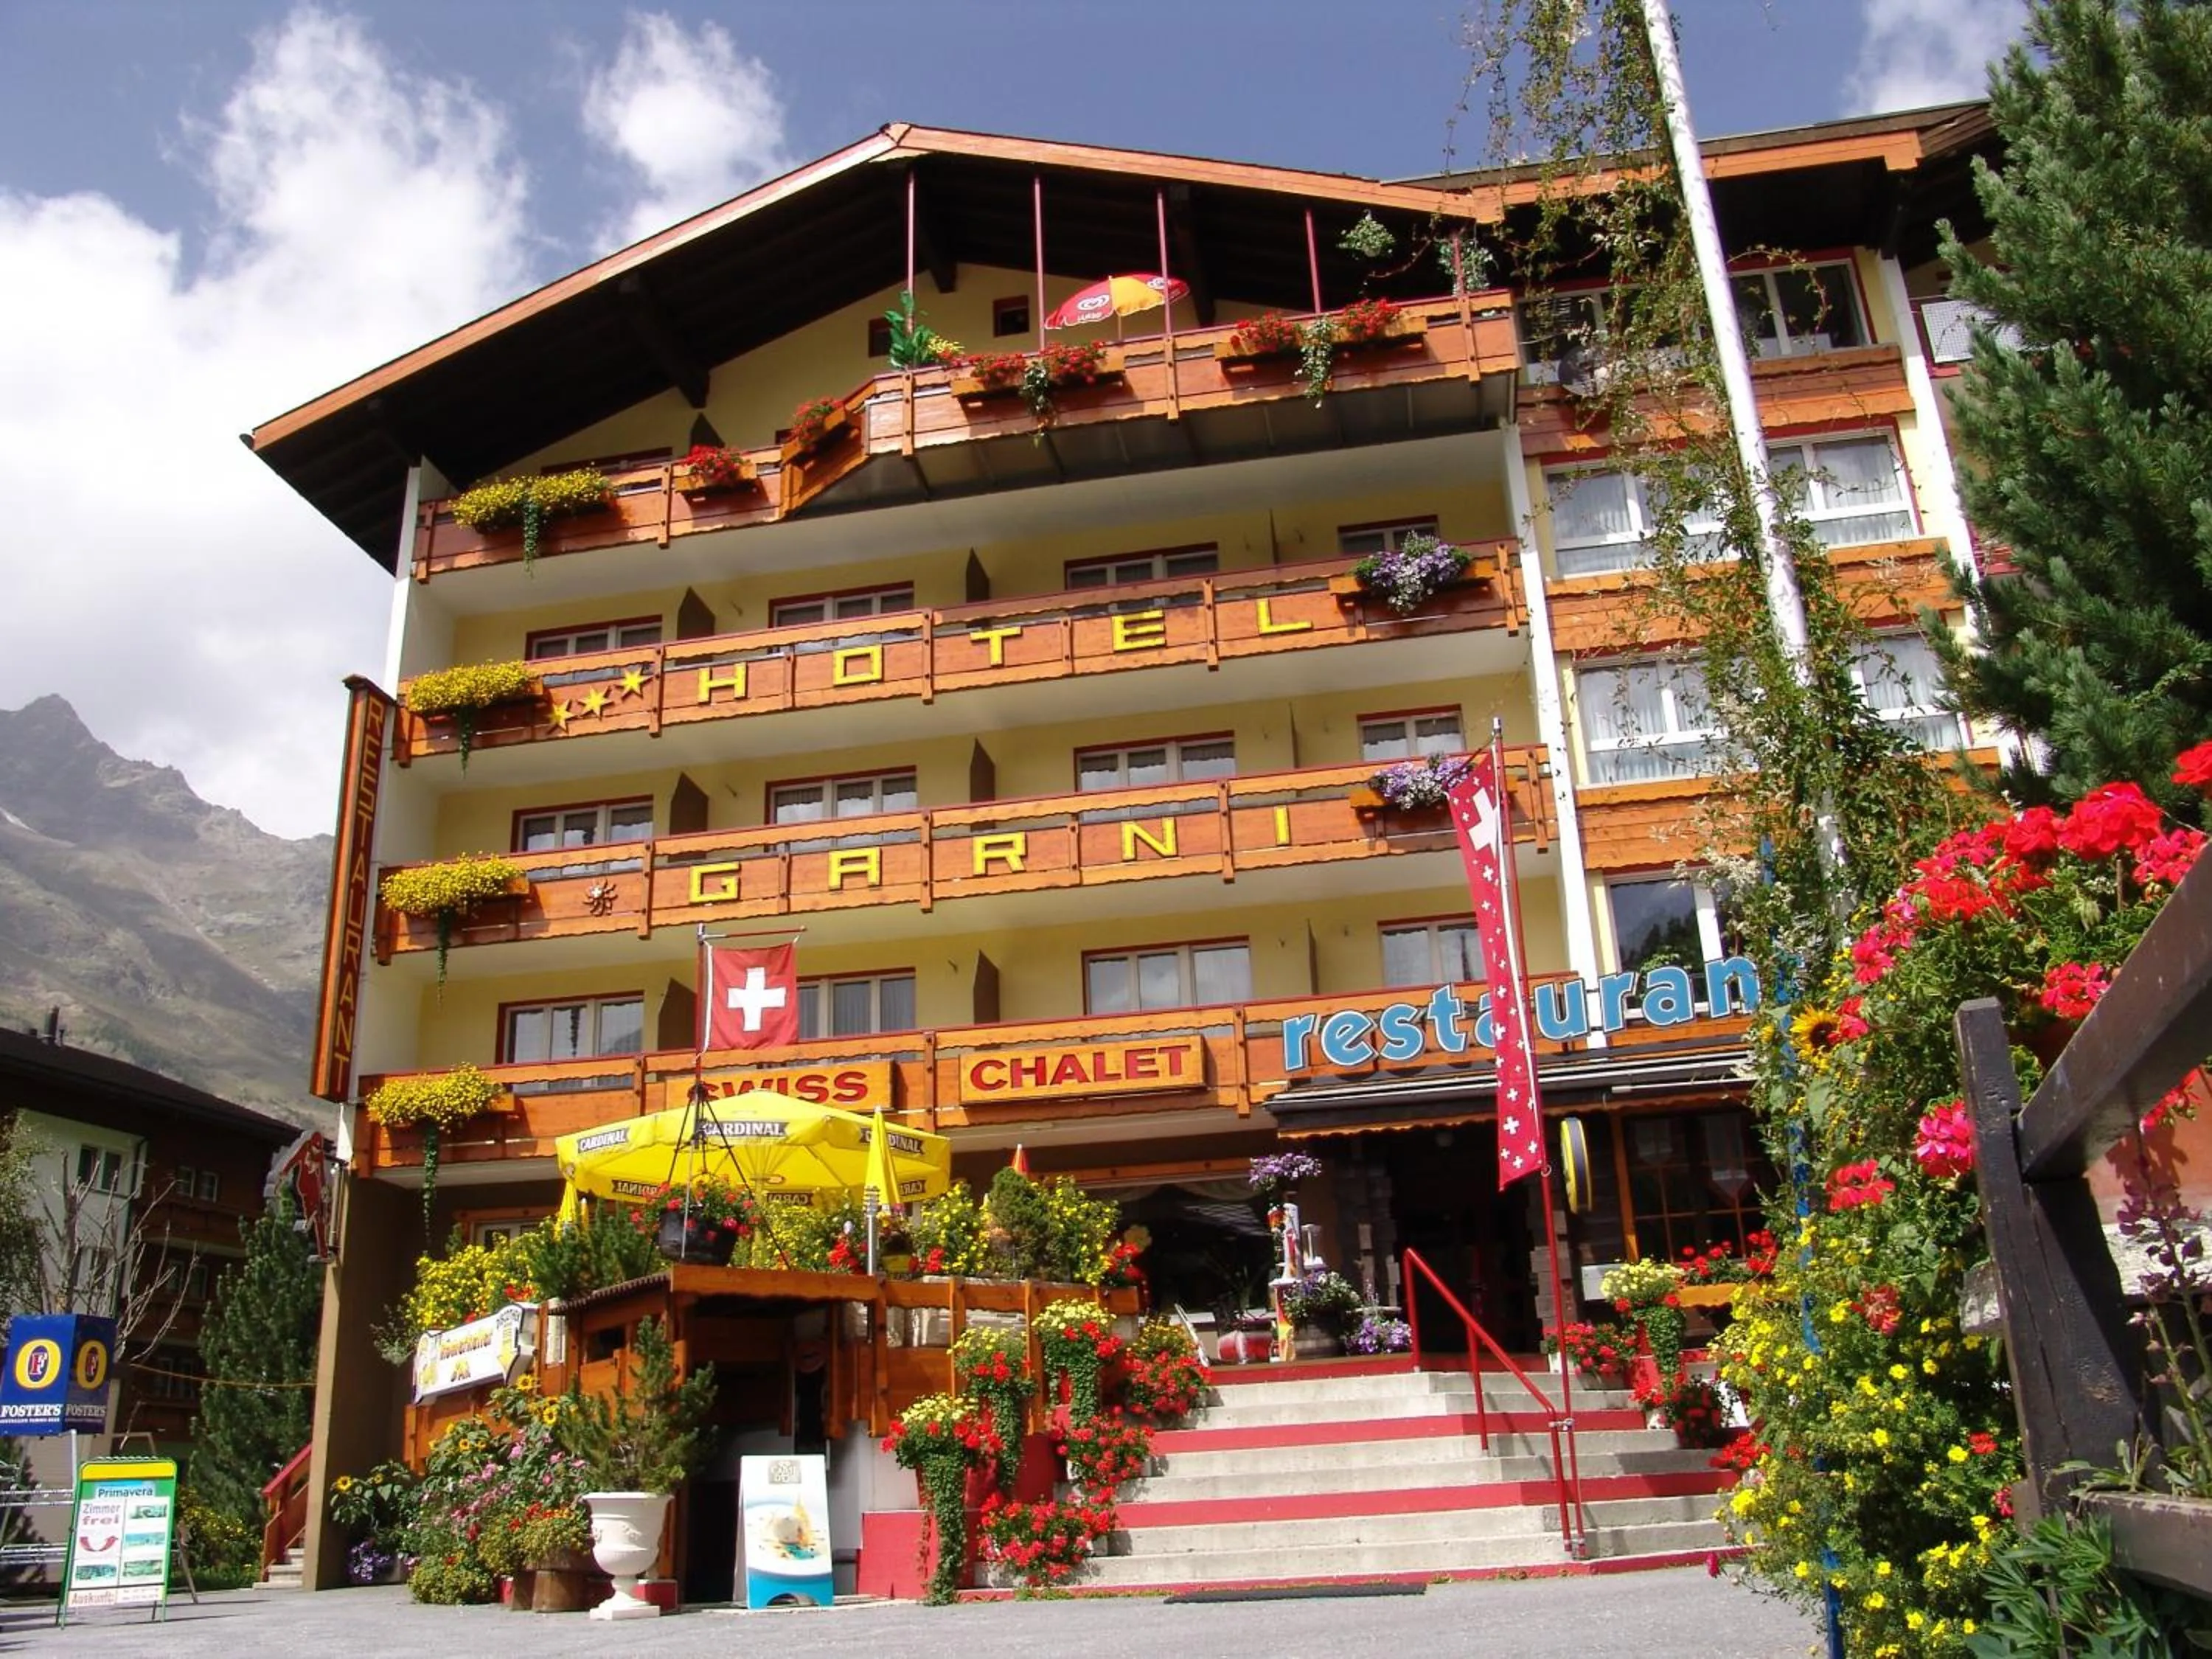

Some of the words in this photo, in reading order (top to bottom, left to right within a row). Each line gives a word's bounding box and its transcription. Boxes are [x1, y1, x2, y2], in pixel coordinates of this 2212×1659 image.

[698, 598, 1312, 703] HOTEL
[689, 805, 1290, 905] GARNI
[333, 700, 386, 1093] RESTAURANT
[970, 1045, 1191, 1091] CHALET
[703, 1121, 785, 1135] CARDINAL
[579, 1130, 627, 1151] CARDINAL
[865, 1130, 921, 1152] CDINAL
[0, 1403, 63, 1417] FOSTER'S
[97, 1486, 154, 1498] Primavera
[82, 1503, 121, 1514] Zimmer
[82, 1515, 119, 1526] frei
